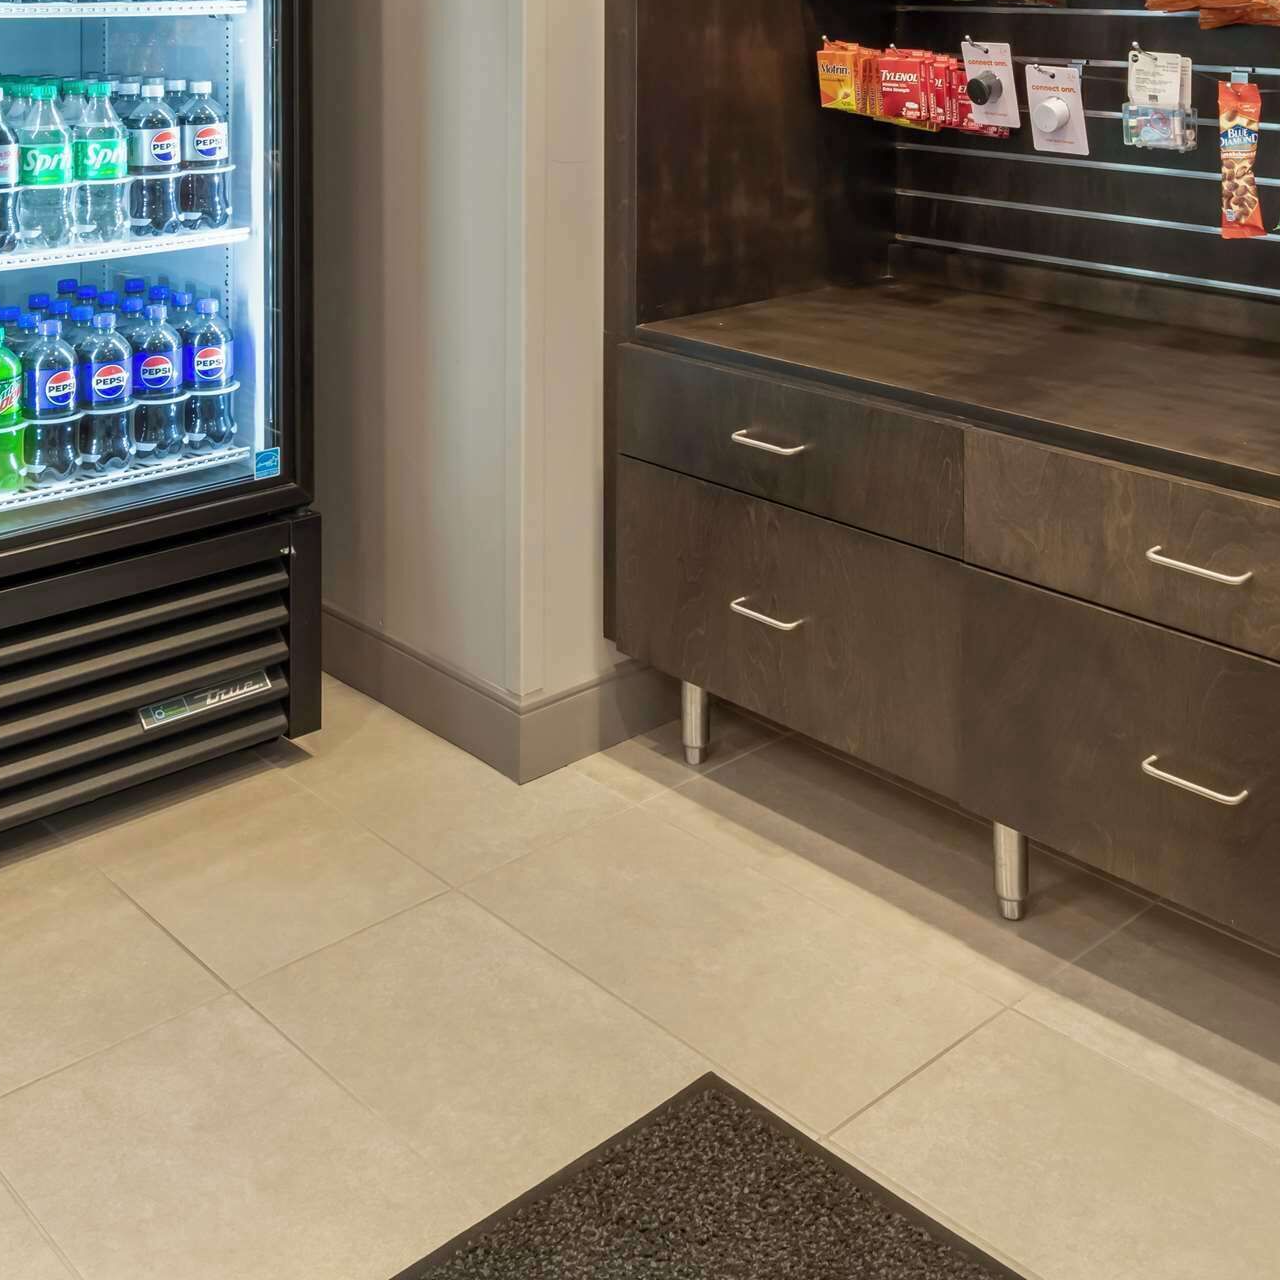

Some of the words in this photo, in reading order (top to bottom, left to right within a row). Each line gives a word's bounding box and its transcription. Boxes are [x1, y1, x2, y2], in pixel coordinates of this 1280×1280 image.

[967, 59, 994, 67] connect
[820, 64, 848, 75] Motrin
[881, 70, 918, 83] TYLENOL
[1031, 84, 1060, 93] connect
[1228, 128, 1248, 138] BLUE
[1220, 133, 1258, 146] DIAMOND
[196, 358, 224, 369] PEPSI
[142, 366, 171, 379] PEPSI
[95, 376, 125, 388] PEPSI
